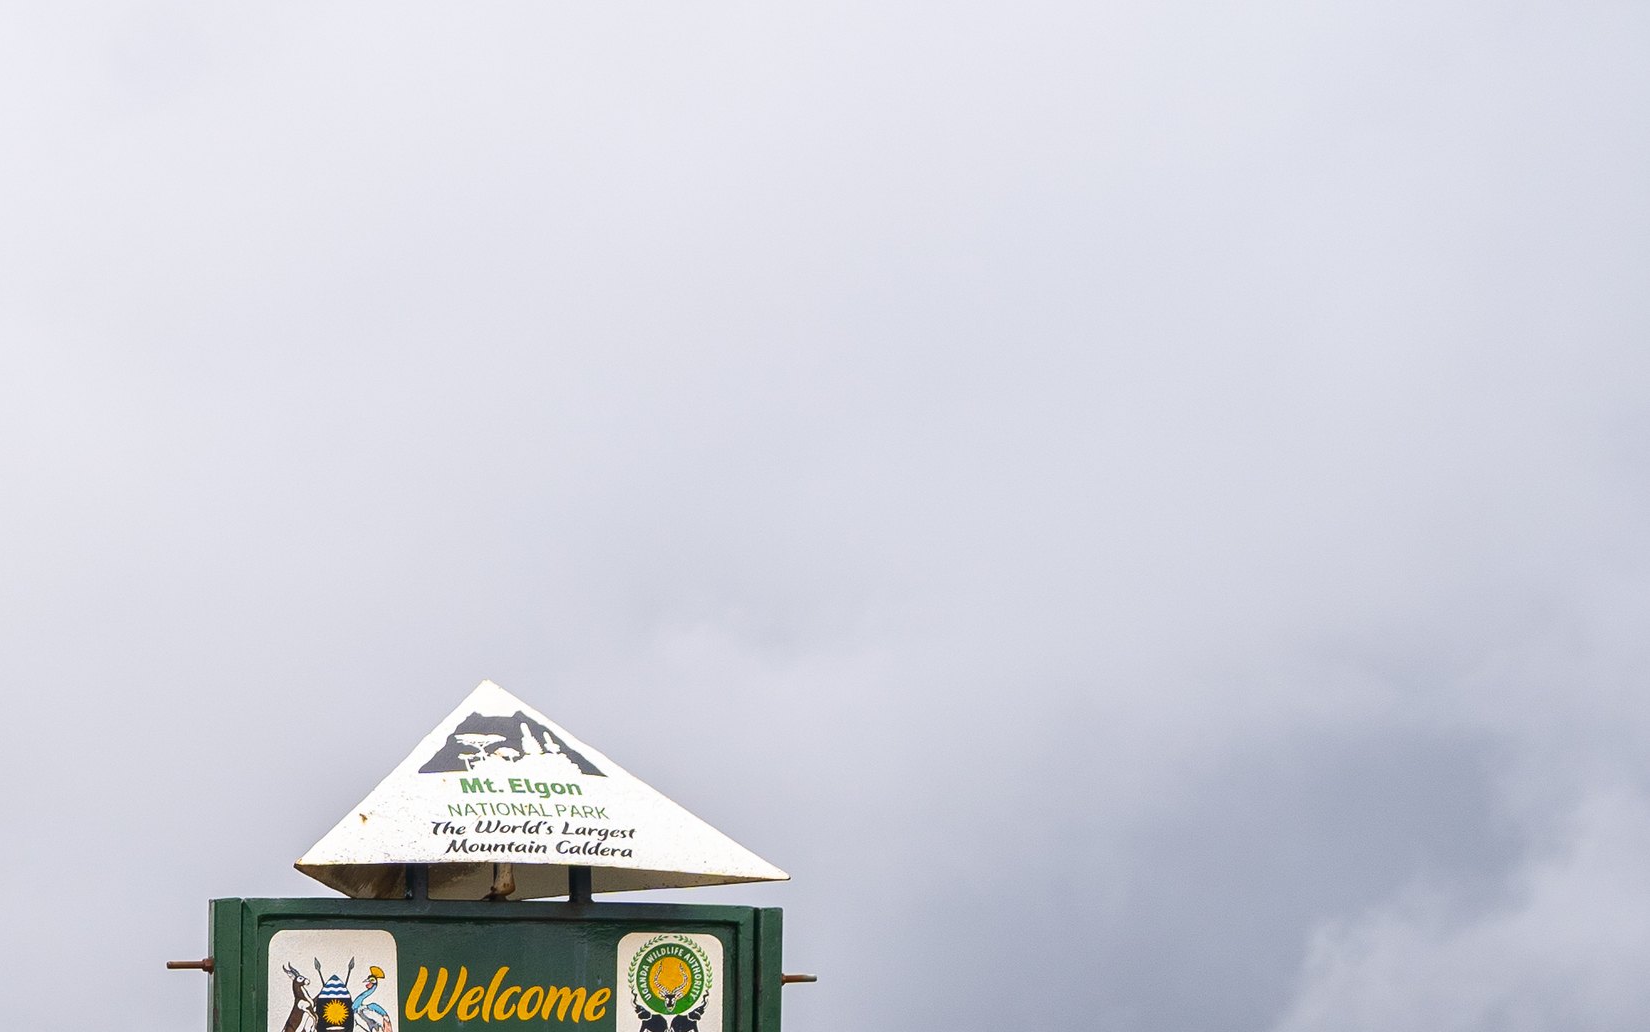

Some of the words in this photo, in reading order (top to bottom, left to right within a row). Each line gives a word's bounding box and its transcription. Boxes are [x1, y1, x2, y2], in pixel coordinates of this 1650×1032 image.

[460, 778, 504, 794] Mt.
[509, 778, 583, 799] Elgon
[448, 802, 552, 818] NATIONAL
[554, 803, 610, 819] PARK
[431, 820, 466, 836] The
[475, 820, 553, 836] World's
[561, 822, 637, 841] Largest
[445, 839, 548, 856] Mountain
[555, 841, 634, 859] Caldera
[639, 963, 653, 1001] UGANDA
[646, 946, 685, 964] WILDLIFE
[684, 953, 703, 1001] AUTHORITY
[404, 965, 611, 1023] Welcome
